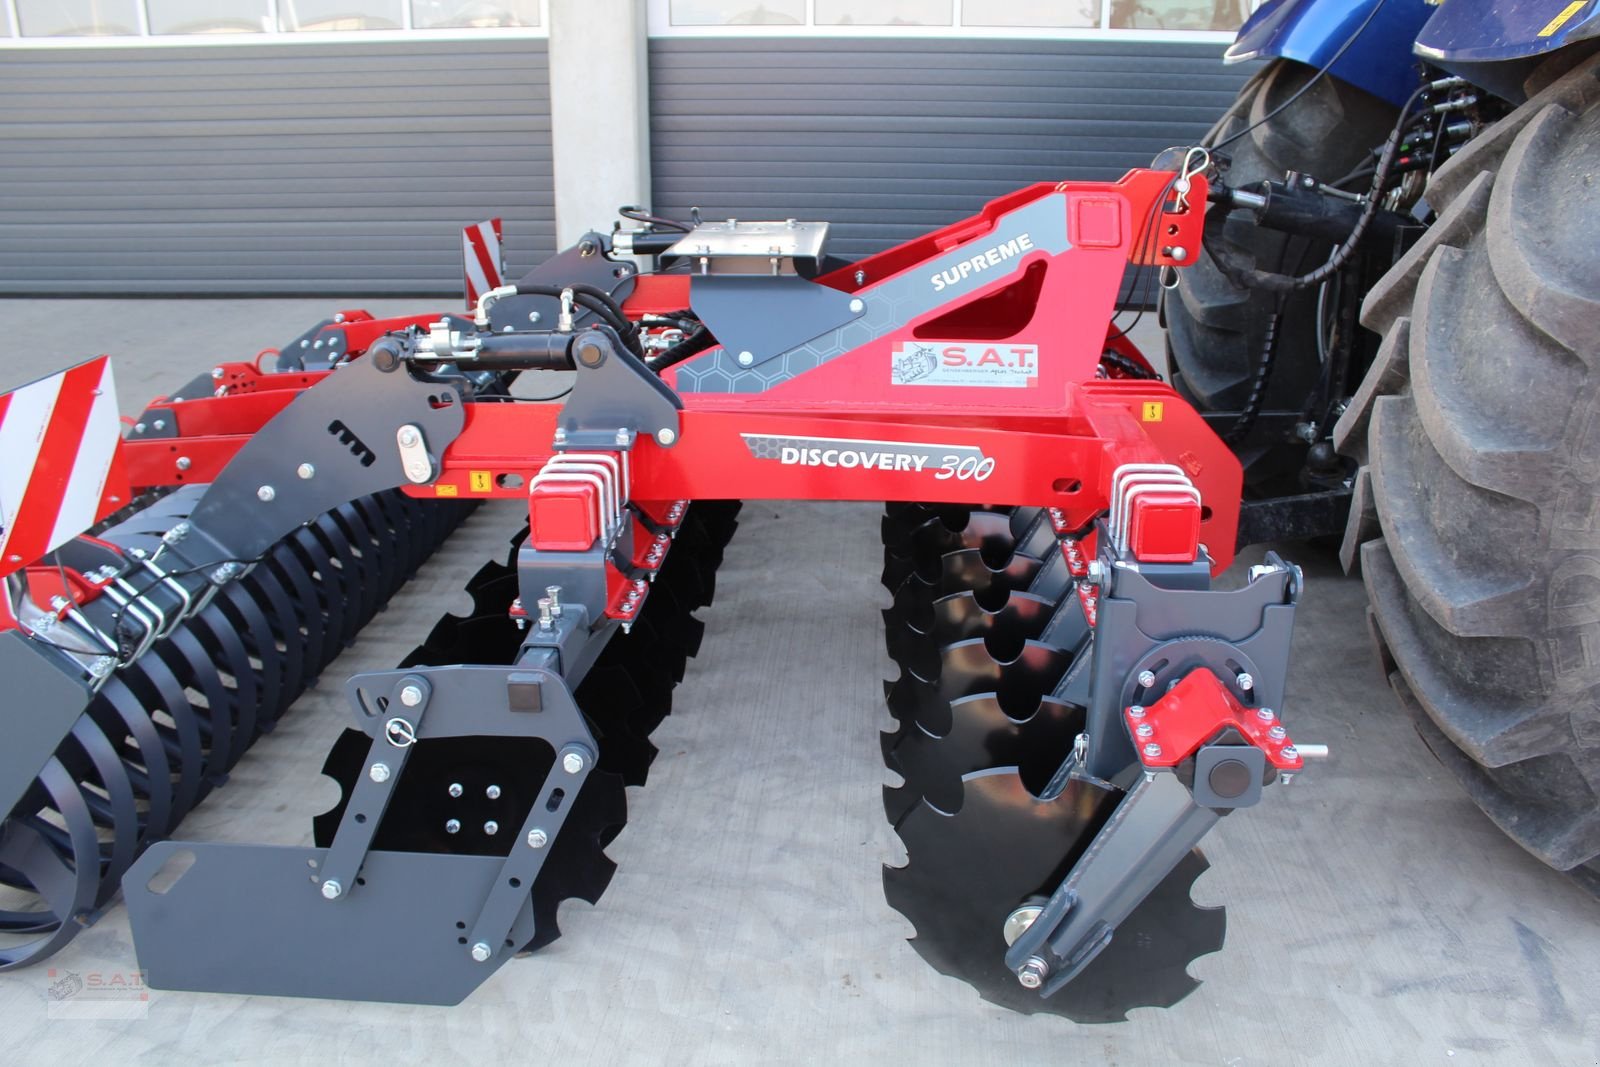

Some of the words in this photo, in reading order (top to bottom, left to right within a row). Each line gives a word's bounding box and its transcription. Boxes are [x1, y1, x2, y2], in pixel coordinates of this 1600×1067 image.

[930, 233, 1034, 292] SUPREME
[942, 346, 1034, 367] S.A.T.
[780, 447, 929, 472] DISCOVERY
[934, 455, 996, 481] 300
